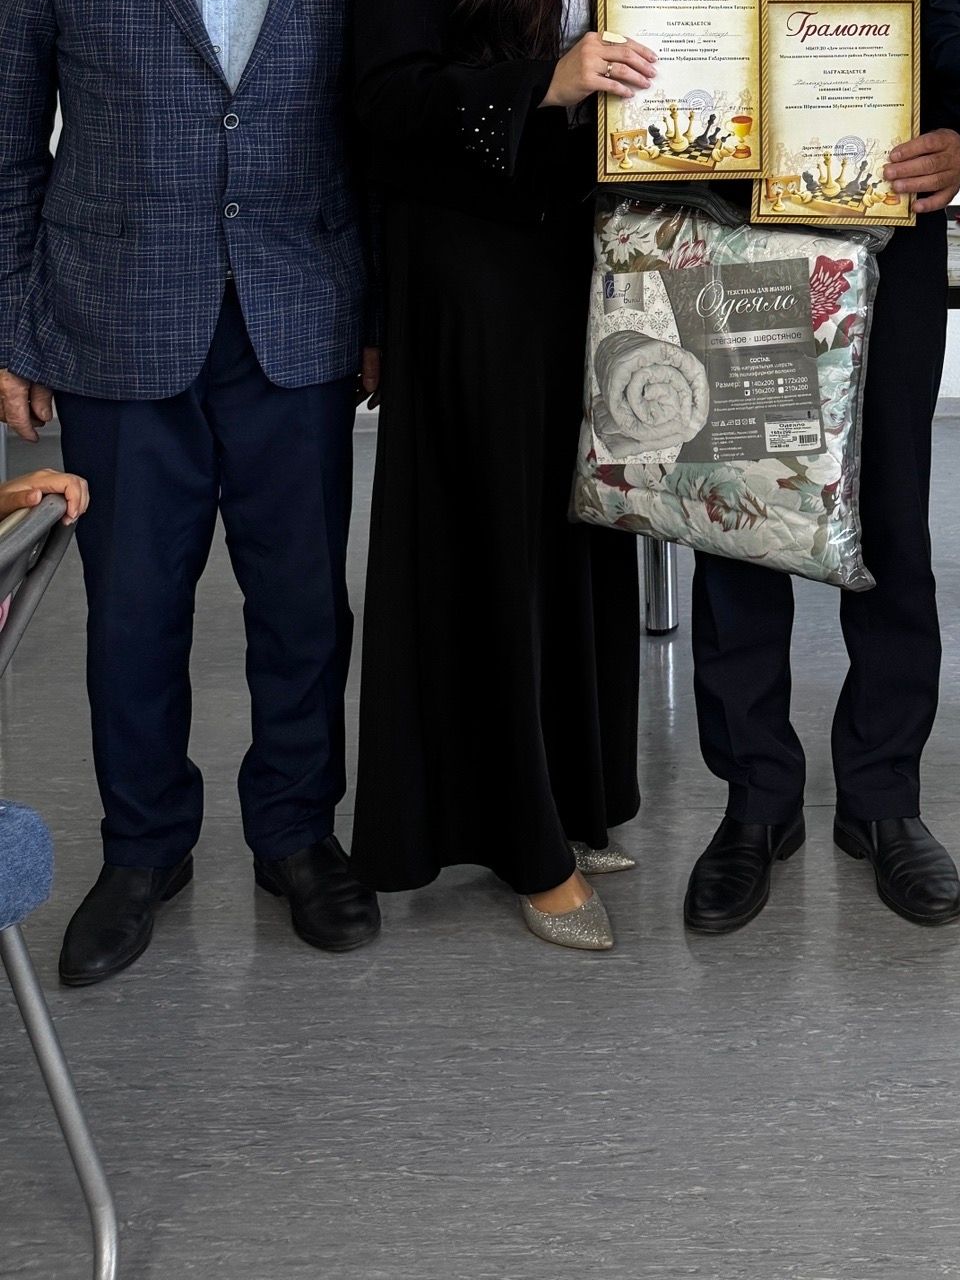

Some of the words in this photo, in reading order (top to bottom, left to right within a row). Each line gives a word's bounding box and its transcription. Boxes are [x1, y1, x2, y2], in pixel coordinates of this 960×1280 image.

[786, 11, 891, 43] Грамота
[696, 280, 799, 332] Одеяло
[754, 331, 802, 343] шерстяное
